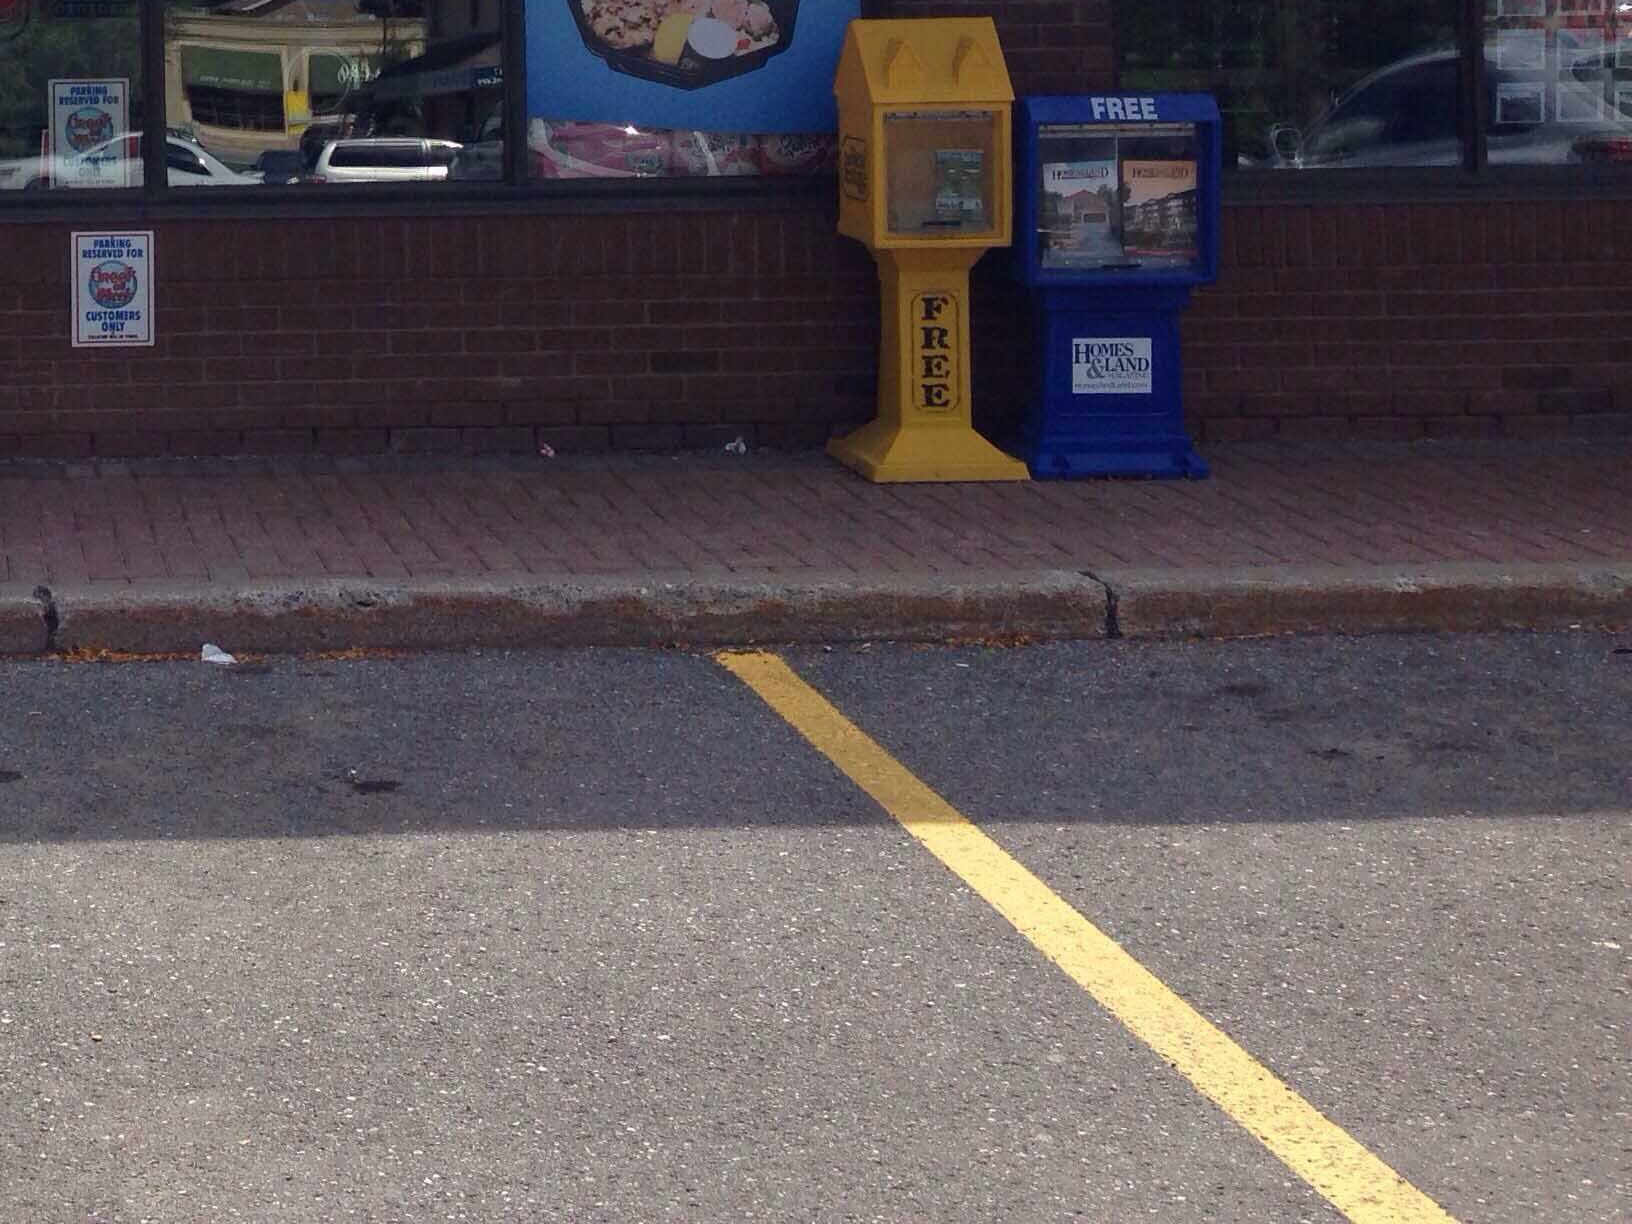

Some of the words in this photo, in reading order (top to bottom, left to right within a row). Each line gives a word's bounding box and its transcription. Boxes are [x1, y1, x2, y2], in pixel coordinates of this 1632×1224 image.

[1090, 97, 1159, 120] FREE
[93, 239, 132, 249] PARKING
[82, 249, 124, 258] RESERVED
[126, 249, 144, 258] FOR
[85, 310, 142, 321] CUSTOMERS
[101, 322, 126, 332] ONLY
[920, 296, 951, 408] FREE
[1074, 343, 1135, 365] HOMES
